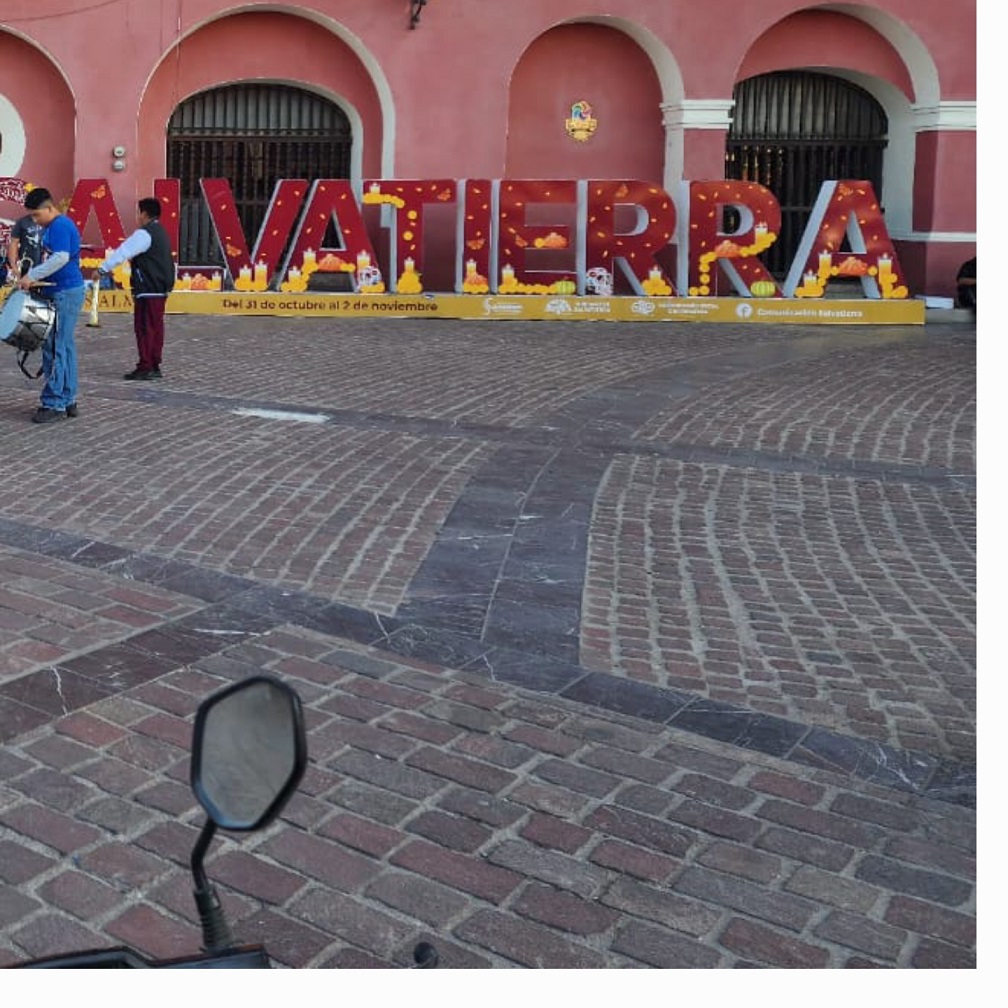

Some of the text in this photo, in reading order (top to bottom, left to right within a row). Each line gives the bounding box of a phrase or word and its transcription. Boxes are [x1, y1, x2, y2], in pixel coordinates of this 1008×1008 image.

[223, 299, 438, 312] Del 31 de octubre al 2 de noviembre
